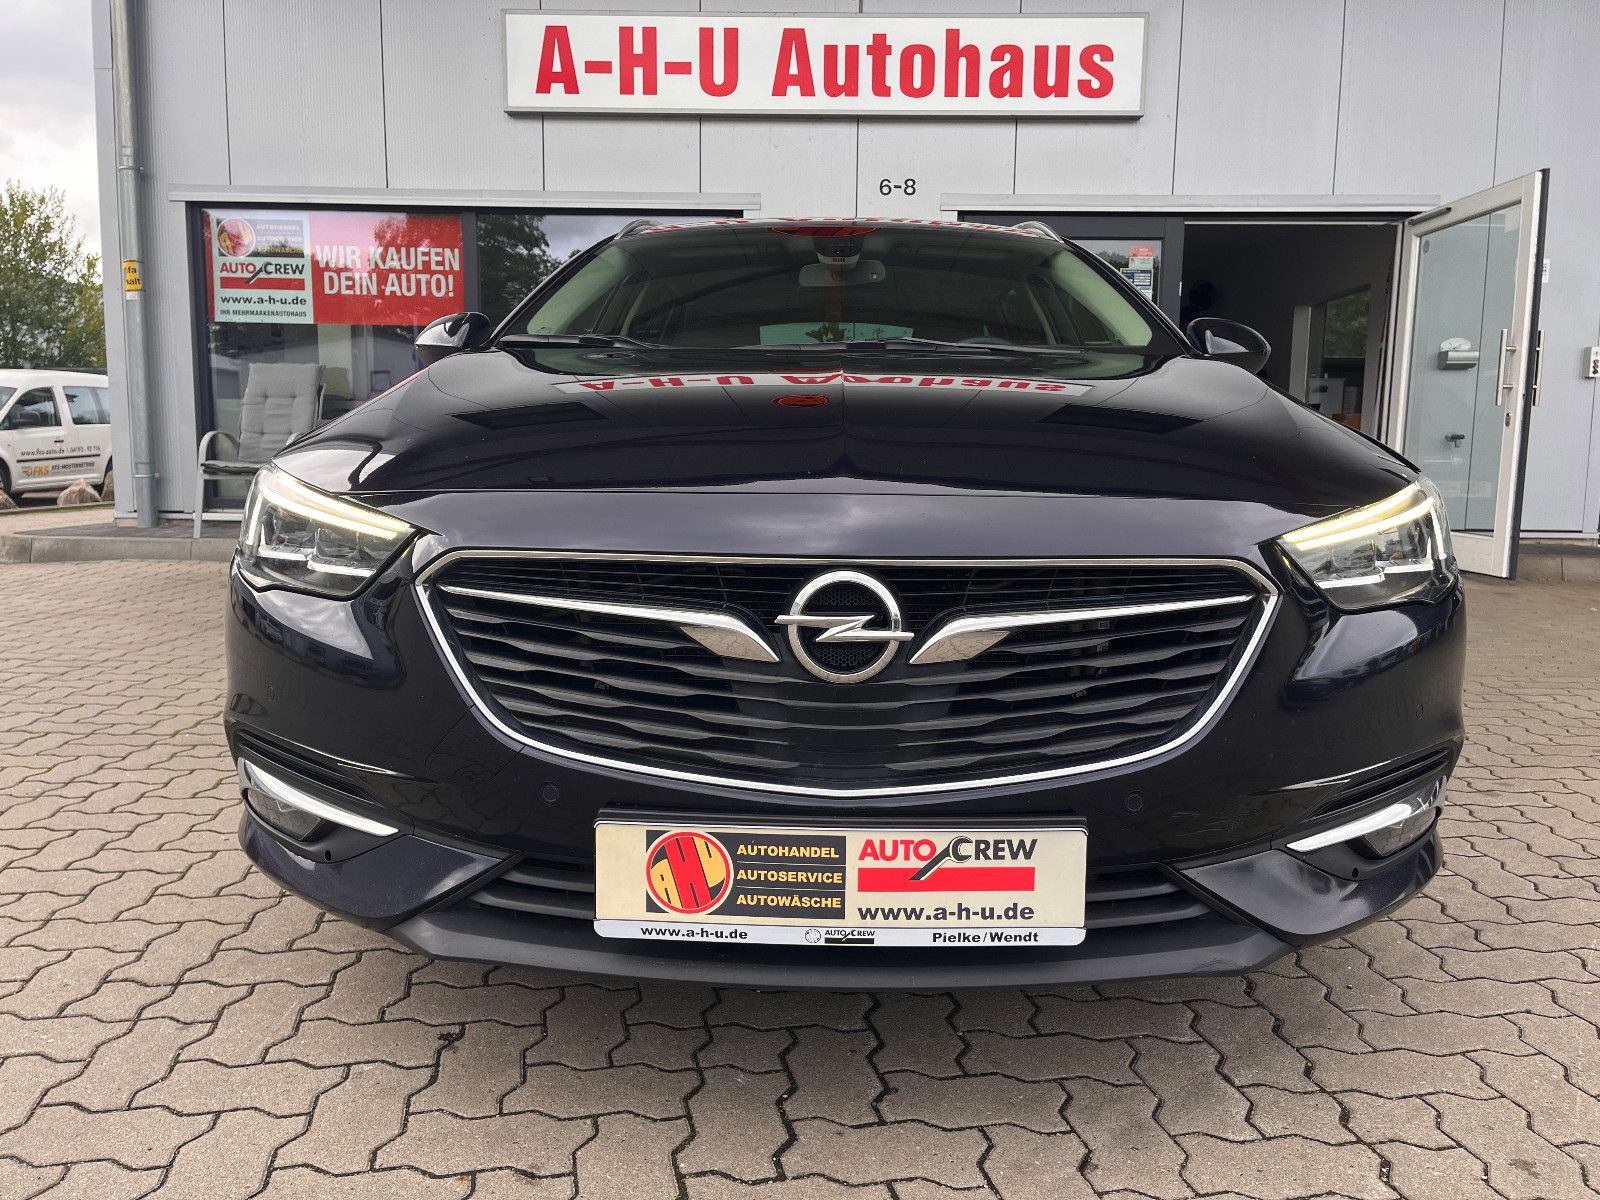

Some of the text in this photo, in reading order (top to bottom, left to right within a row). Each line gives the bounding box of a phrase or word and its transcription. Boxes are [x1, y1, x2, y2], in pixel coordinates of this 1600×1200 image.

[535, 25, 1114, 98] A-H-U Autohaus
[878, 178, 917, 195] 6-8
[315, 244, 460, 271] WIR KAUFEN
[323, 271, 454, 297] DEIN AUTO!
[220, 295, 307, 305] www.a-h-u.de
[737, 844, 839, 858] AUTOHANDEL
[737, 869, 843, 883] AUTOSERVICE
[736, 894, 841, 908] AUTOWÄSCHE
[857, 902, 1035, 920] www.a-h-u.de
[640, 927, 748, 940] www.a-h-u.de
[932, 931, 1039, 943] Pielke/Wendt
